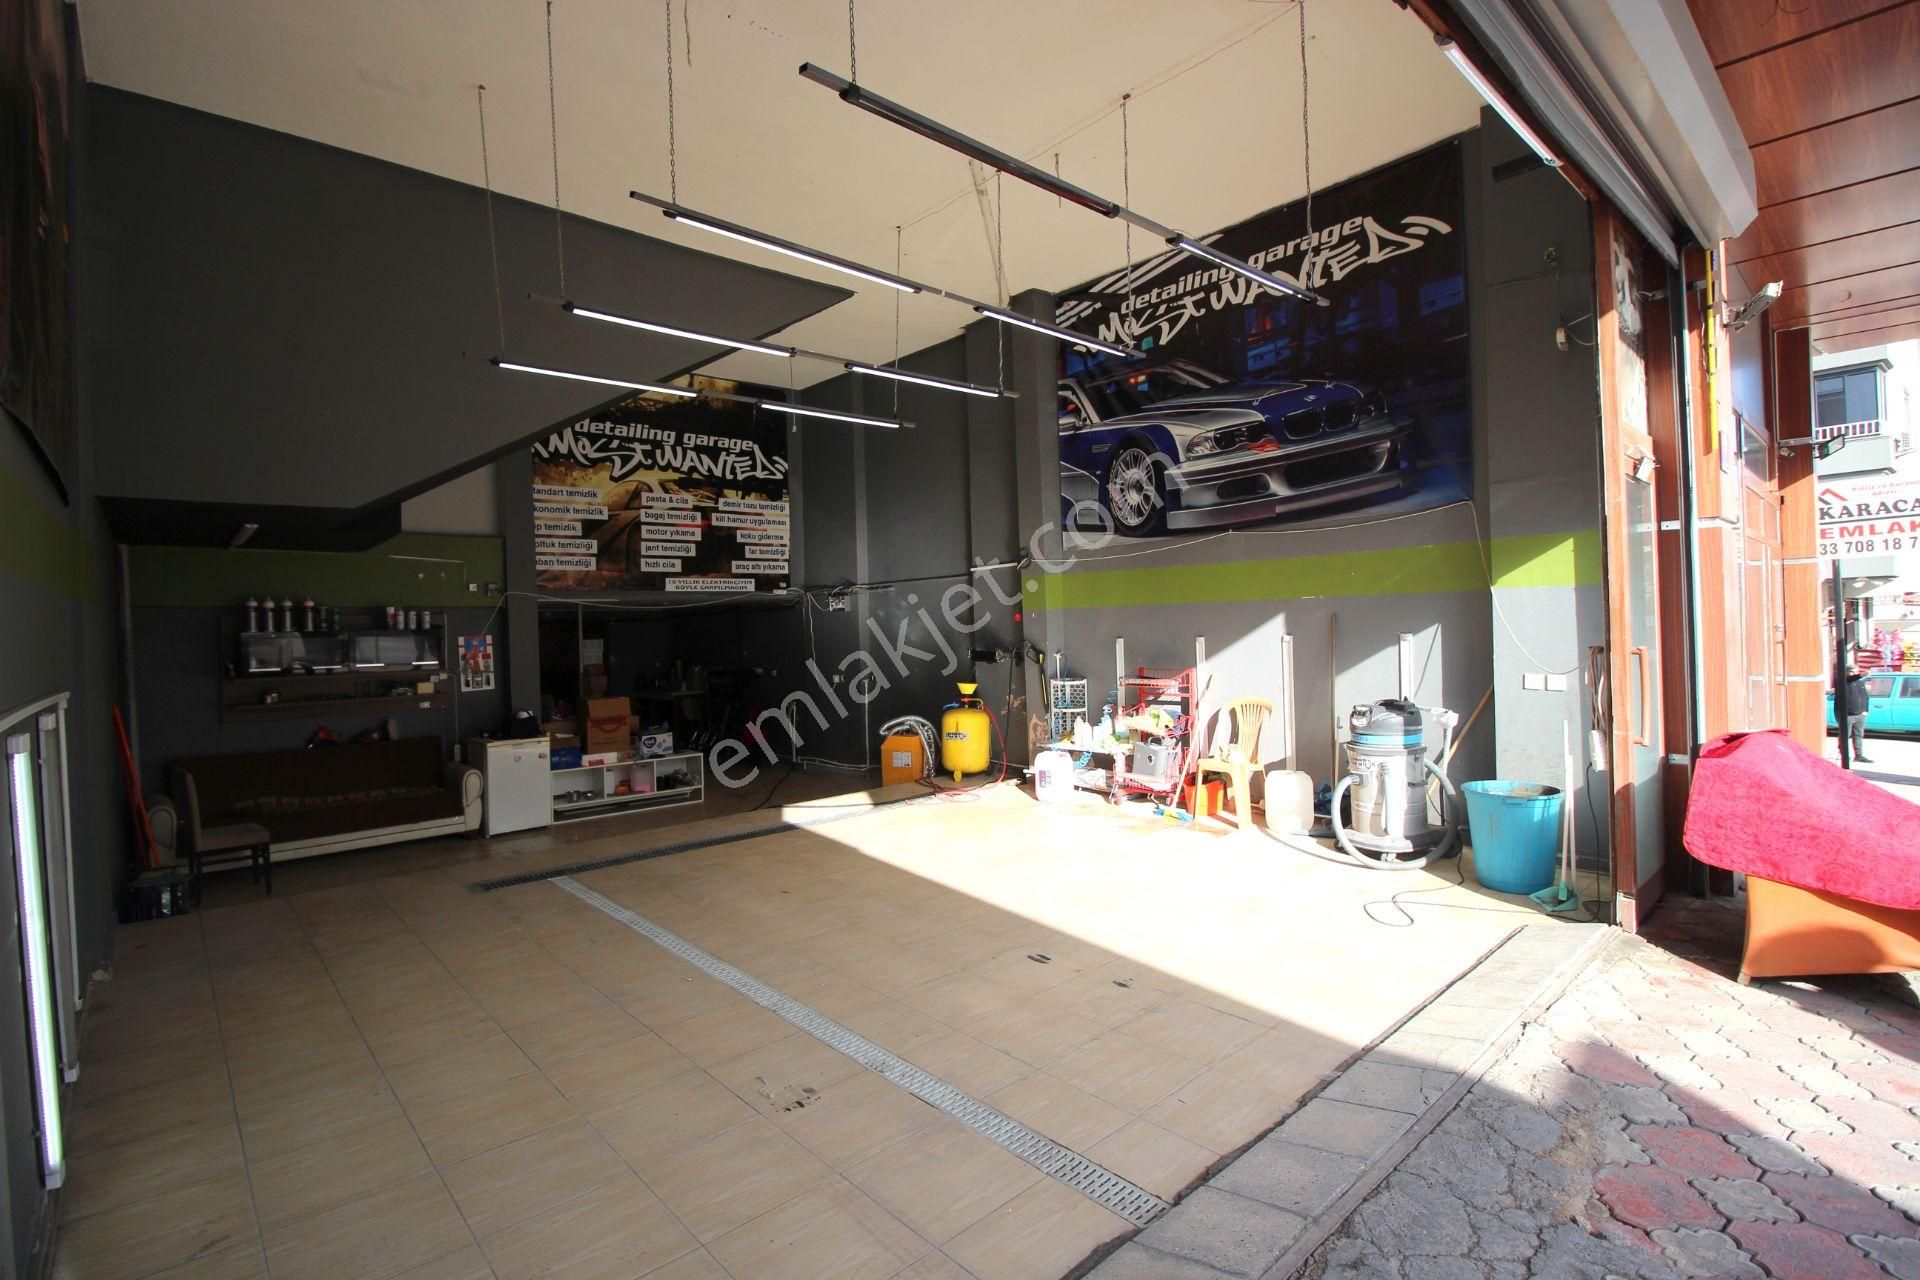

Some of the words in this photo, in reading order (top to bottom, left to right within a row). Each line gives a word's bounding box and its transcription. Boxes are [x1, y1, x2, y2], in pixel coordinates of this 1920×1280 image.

[1120, 263, 1239, 315] detailing
[1247, 216, 1366, 268] garage
[573, 418, 677, 446] detailing
[683, 433, 753, 452] garage
[533, 487, 564, 497] tandart
[566, 489, 598, 498] temizlik
[646, 495, 667, 504] pasta
[676, 496, 689, 505] cila
[534, 505, 571, 514] konomik
[573, 507, 604, 516] temizlik
[759, 503, 786, 512] temizliği
[1819, 498, 1920, 521] KARACA
[644, 512, 666, 522] bagaj
[667, 512, 698, 522] temizliği
[749, 517, 787, 526] uygulaması
[544, 523, 577, 532] temizlik
[1820, 520, 1920, 540] EMLAK
[670, 529, 696, 538] yıkama
[740, 531, 756, 540] koku
[758, 533, 784, 541] giderme
[534, 540, 556, 549] oltuk
[558, 541, 593, 551] temizliği
[645, 544, 660, 553] jant
[661, 545, 692, 554] temizliği
[1845, 539, 1875, 554] 708
[1882, 537, 1902, 551] 18
[759, 548, 786, 557] temizliği
[556, 559, 592, 569] temizliği
[645, 560, 661, 568] hızlı
[662, 561, 676, 569] cila
[762, 564, 786, 572] yıkama
